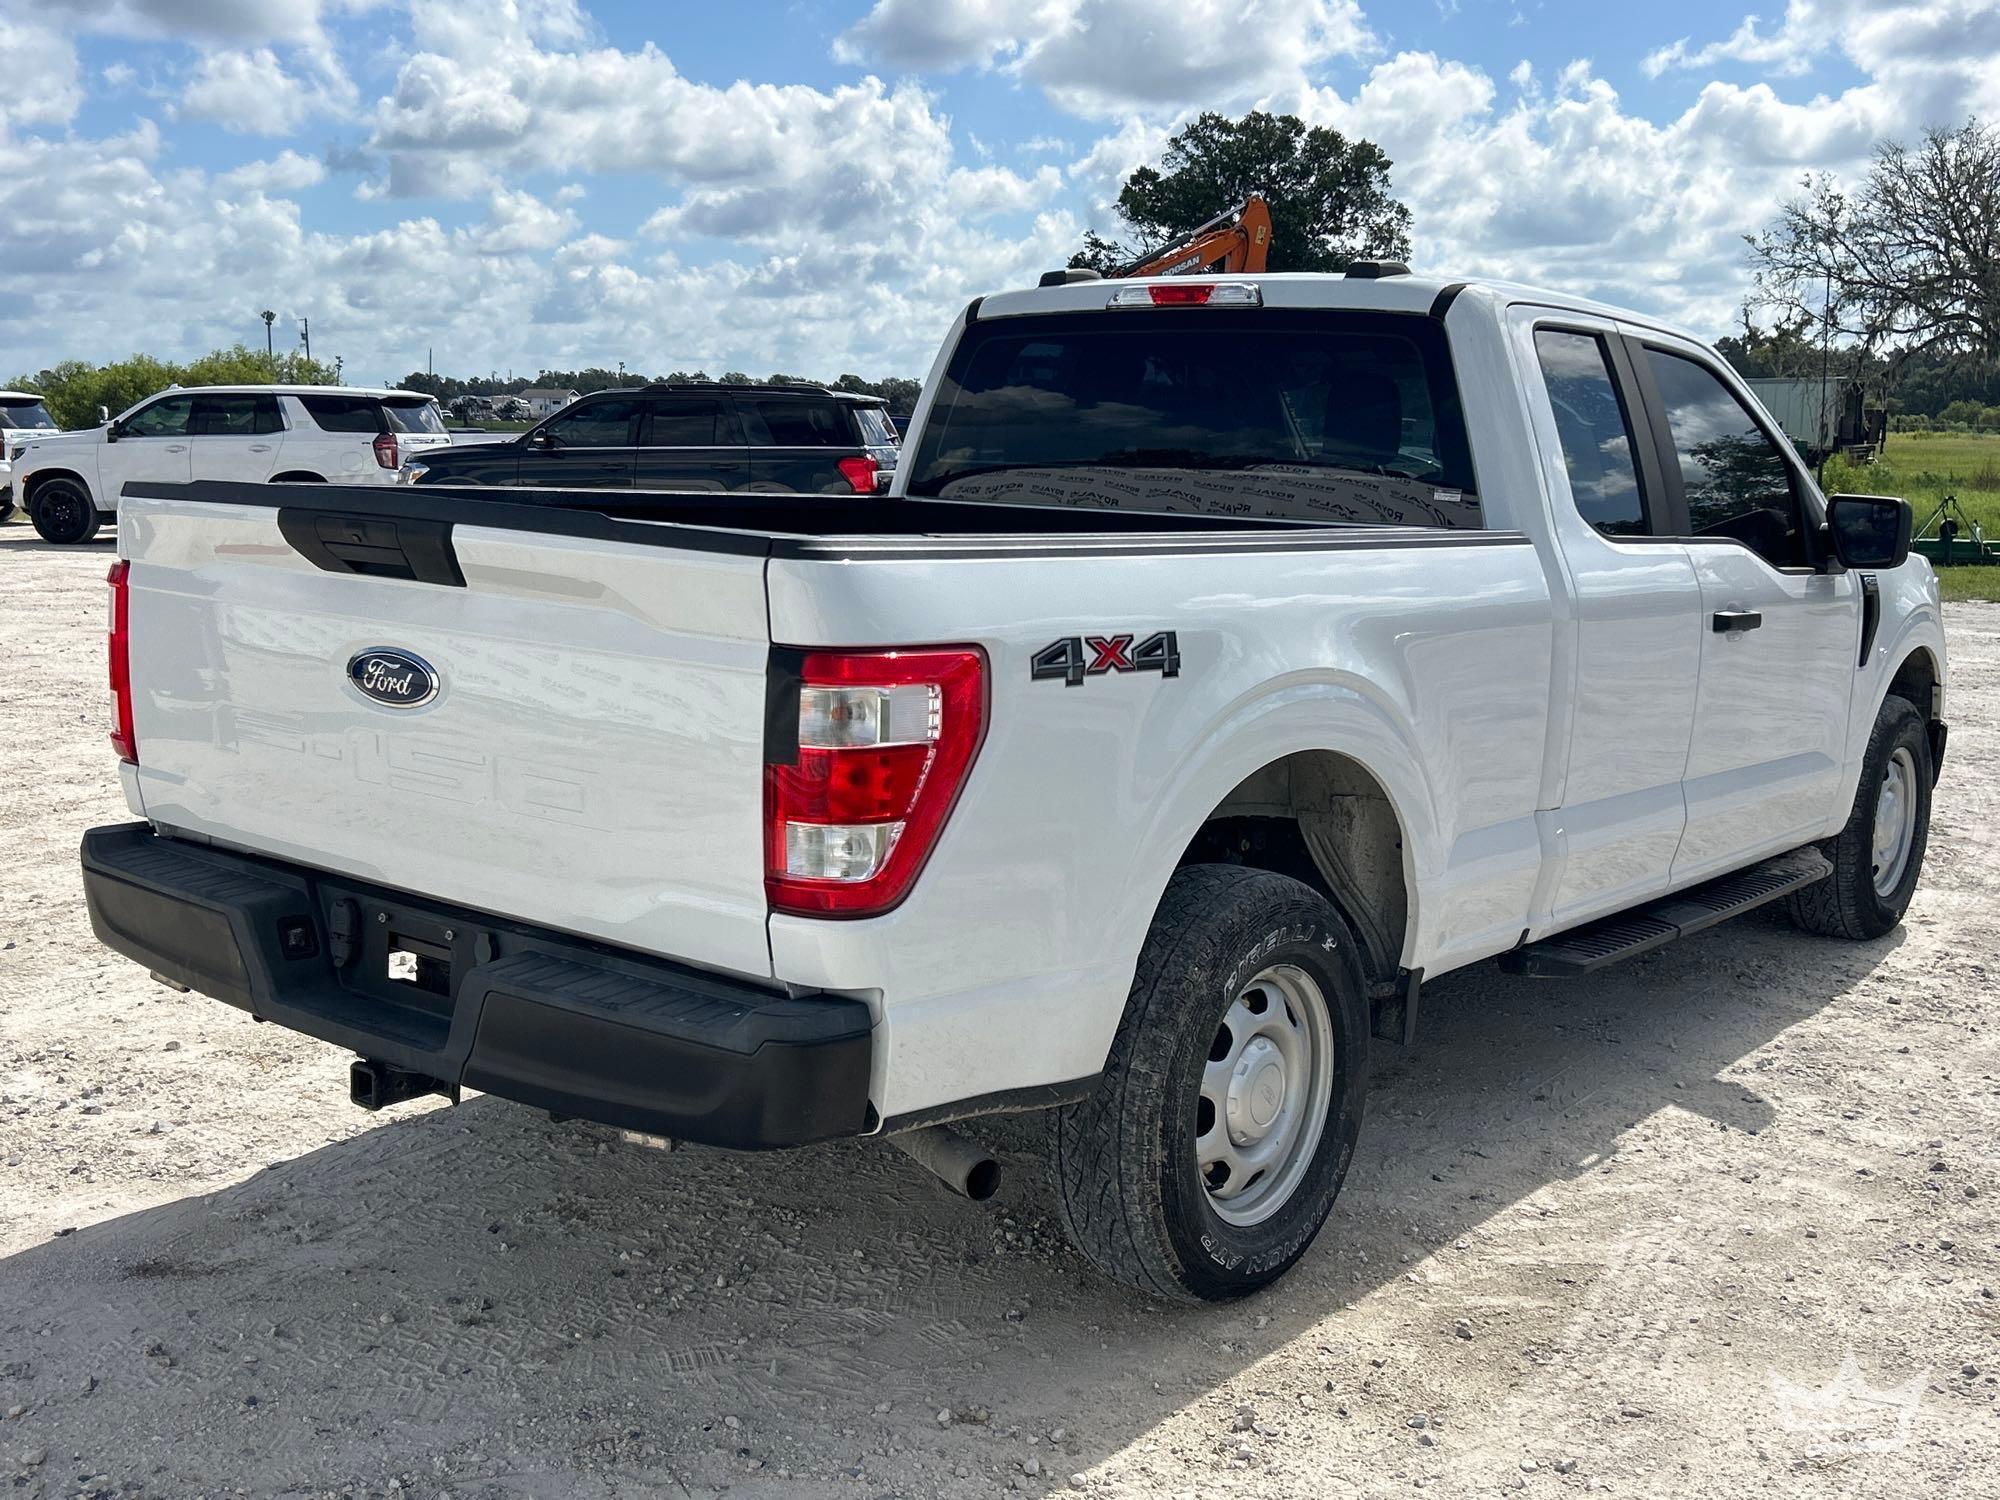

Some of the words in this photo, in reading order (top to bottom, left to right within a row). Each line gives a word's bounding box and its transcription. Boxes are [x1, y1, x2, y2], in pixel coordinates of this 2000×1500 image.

[1161, 256, 1200, 276] DOOSAN
[364, 659, 413, 695] Ford
[1224, 924, 1316, 1000] PIRELLI
[1200, 1231, 1243, 1270] ATR
